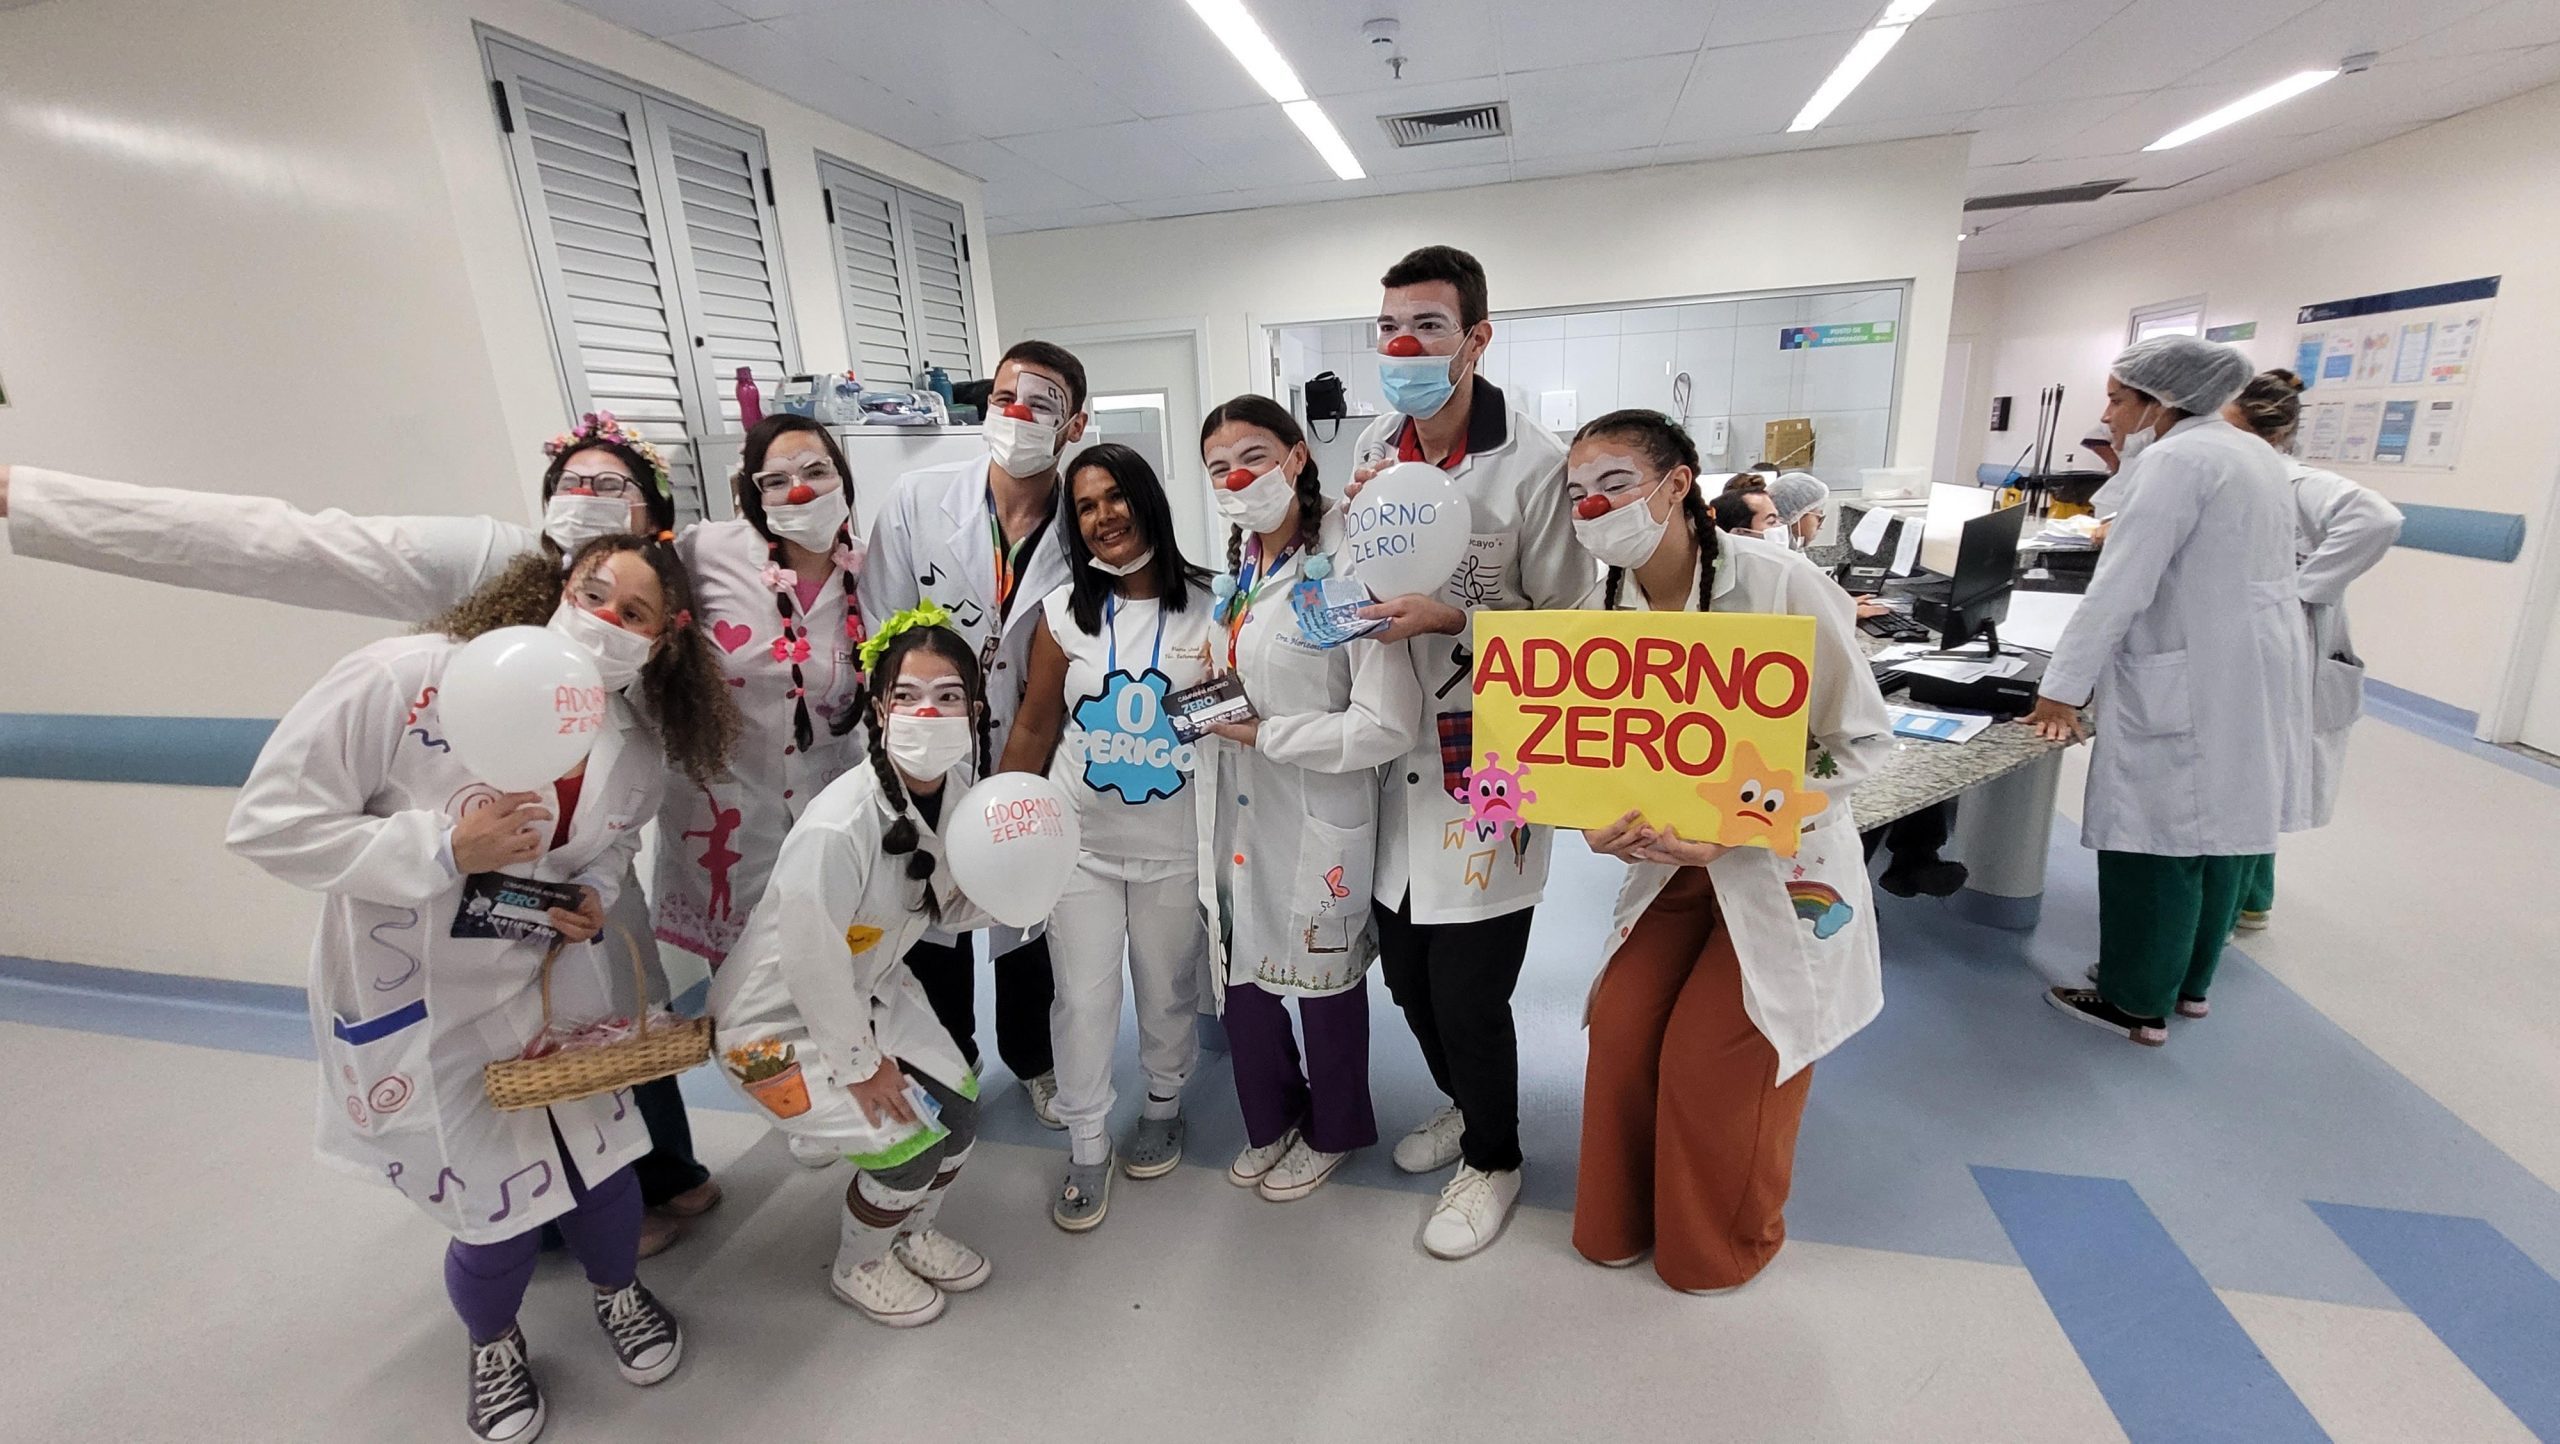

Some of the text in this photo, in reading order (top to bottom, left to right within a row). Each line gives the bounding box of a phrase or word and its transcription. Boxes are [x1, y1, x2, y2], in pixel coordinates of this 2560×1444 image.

[1345, 502, 1436, 540] DORNO
[1352, 532, 1415, 564] ZERO!
[1472, 636, 1809, 719] ADORNO
[1181, 695, 1214, 715] ZERO
[1067, 729, 1196, 772] PERIGO
[1516, 704, 1727, 777] ZERO
[985, 797, 1061, 826] ADORNO
[495, 890, 539, 908] ZERO
